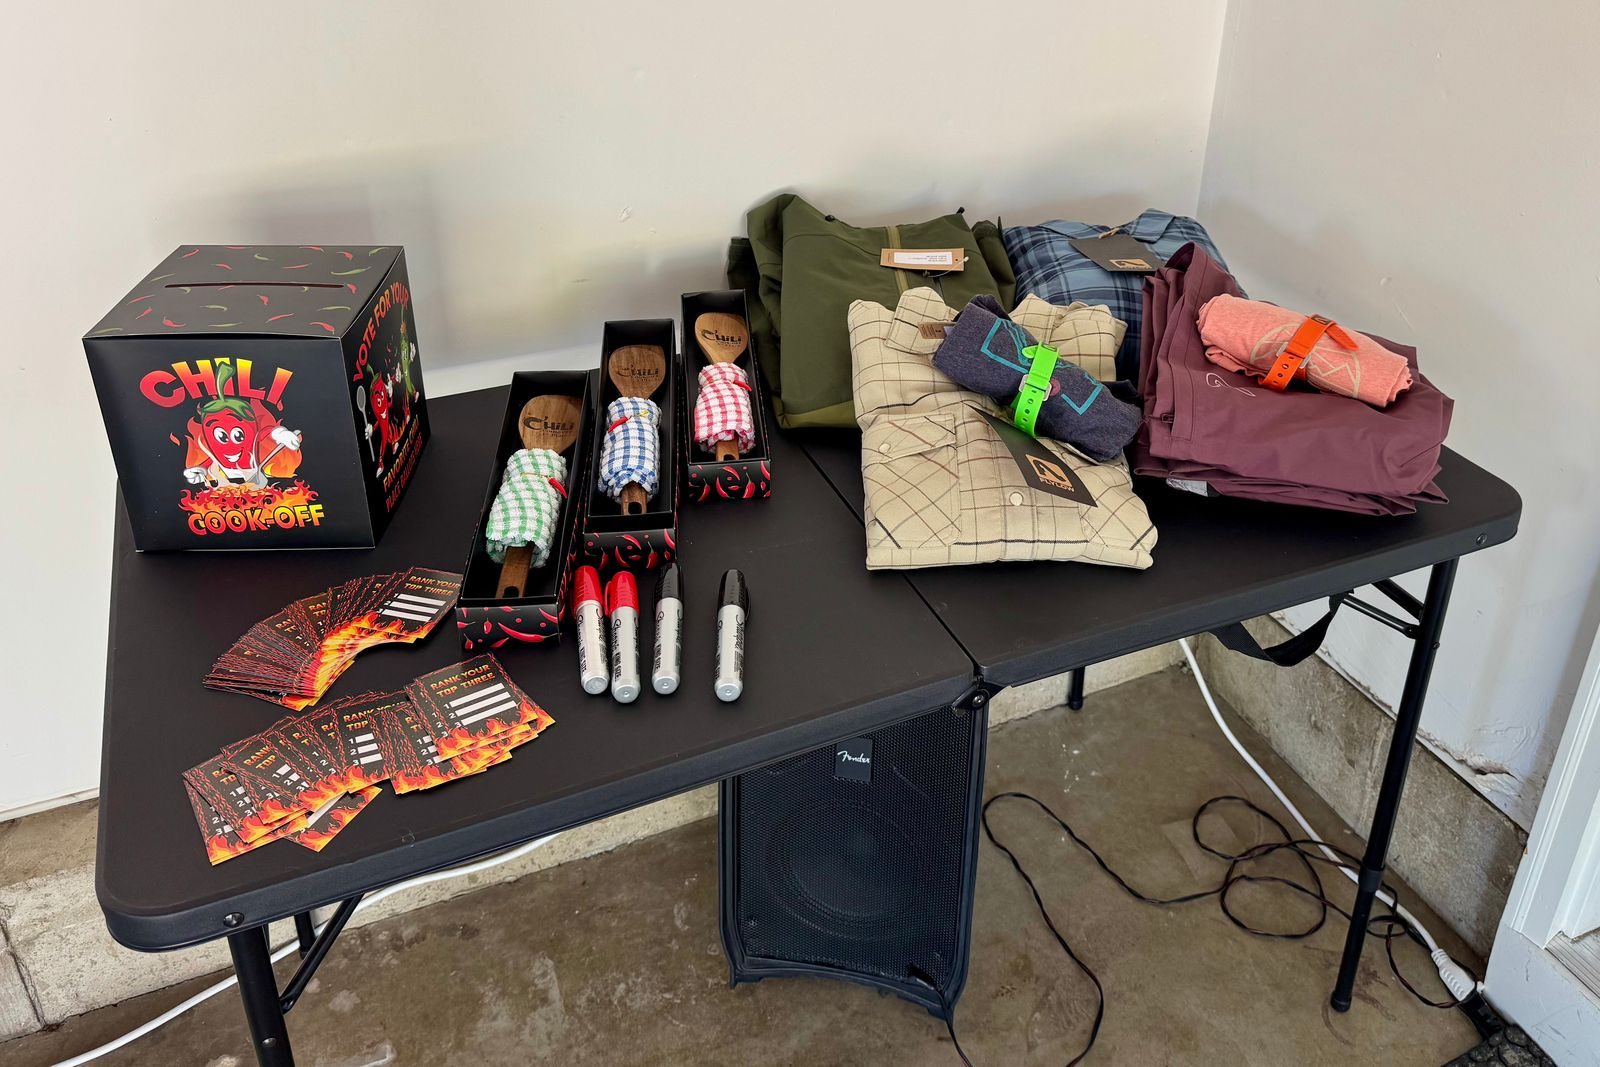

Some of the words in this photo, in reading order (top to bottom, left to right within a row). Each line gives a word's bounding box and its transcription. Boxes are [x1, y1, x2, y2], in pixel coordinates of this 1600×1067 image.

[353, 317, 376, 382] VOTE
[374, 289, 391, 327] FOR
[390, 282, 409, 310] YOUR
[140, 357, 293, 408] CHILI
[188, 504, 325, 535] COOK-OFF
[409, 575, 436, 585] RANK
[437, 580, 461, 589] YOUR
[404, 583, 422, 591] TOP
[424, 586, 454, 596] THREE
[430, 675, 461, 690] RANK
[461, 664, 490, 679] YOUR
[436, 686, 458, 698] TOP
[460, 672, 496, 689] THREE
[346, 720, 368, 731] TOP
[255, 754, 276, 769] TOP
[837, 750, 871, 763] Fender
[296, 785, 305, 793] 3
[212, 817, 220, 825] 2
[215, 828, 223, 836] 3
